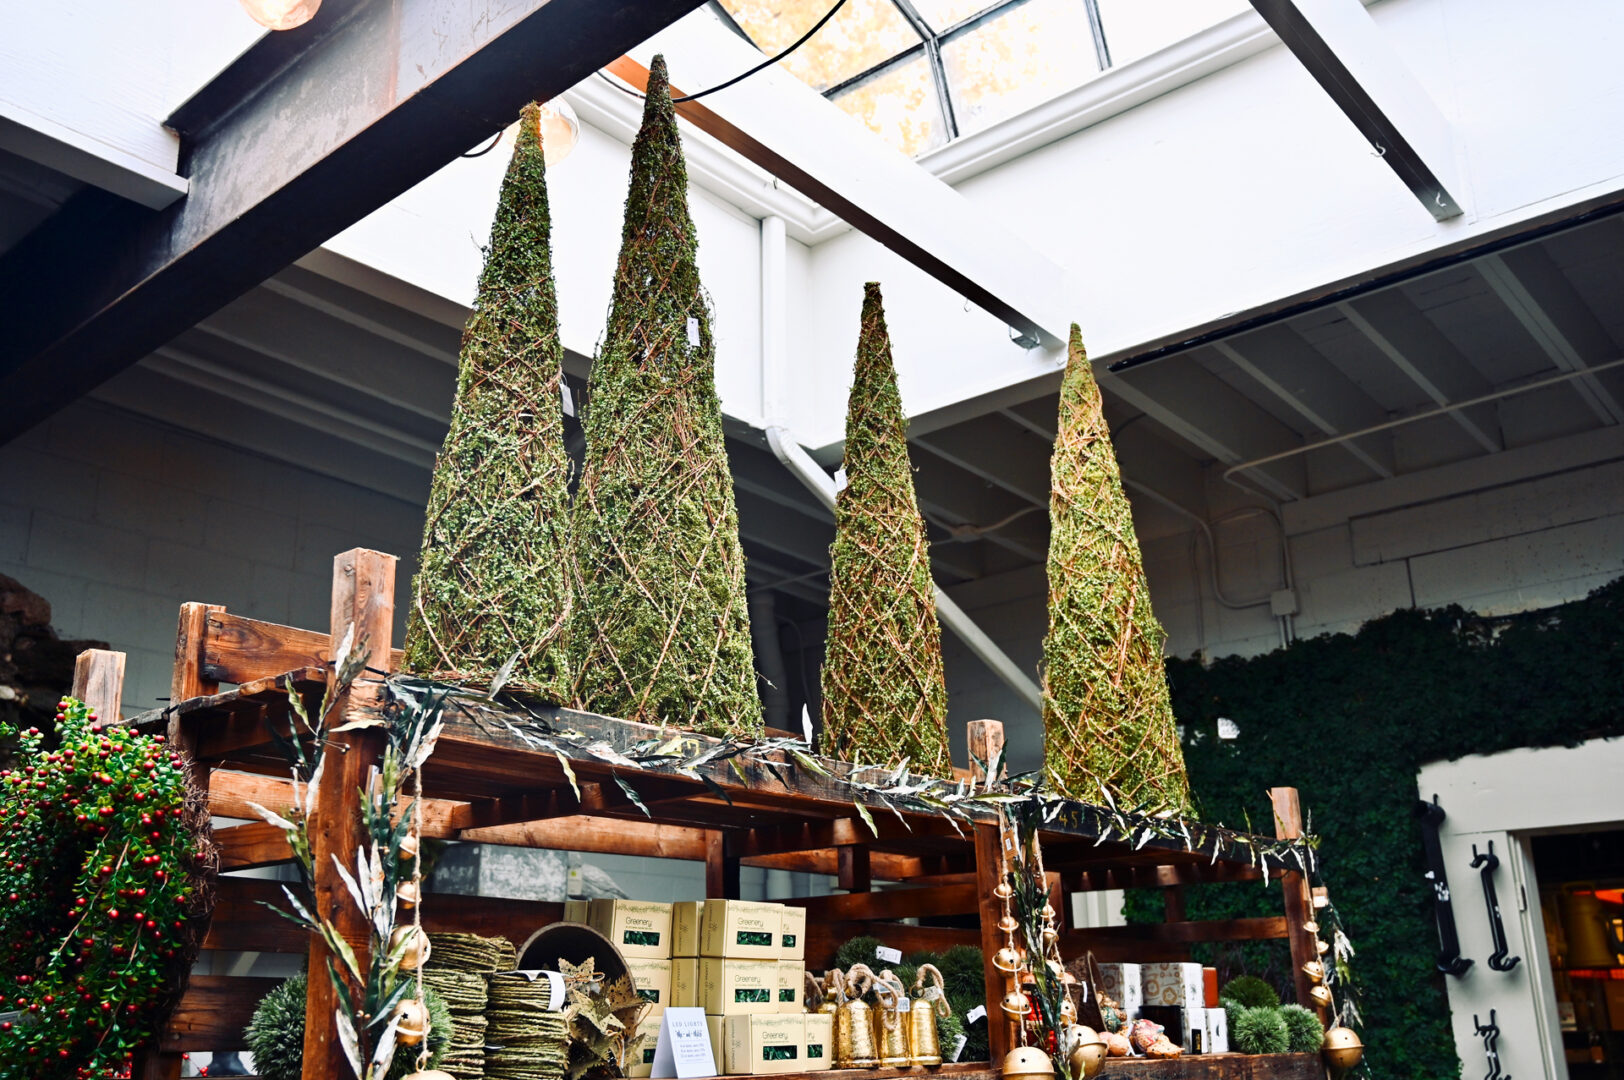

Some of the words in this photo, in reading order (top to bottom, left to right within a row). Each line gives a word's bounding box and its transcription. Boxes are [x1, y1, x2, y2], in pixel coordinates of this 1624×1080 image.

[625, 916, 653, 928] Greenery
[737, 917, 764, 927] Greenery
[735, 974, 761, 983] Greenery
[762, 1031, 789, 1040] Greenery
